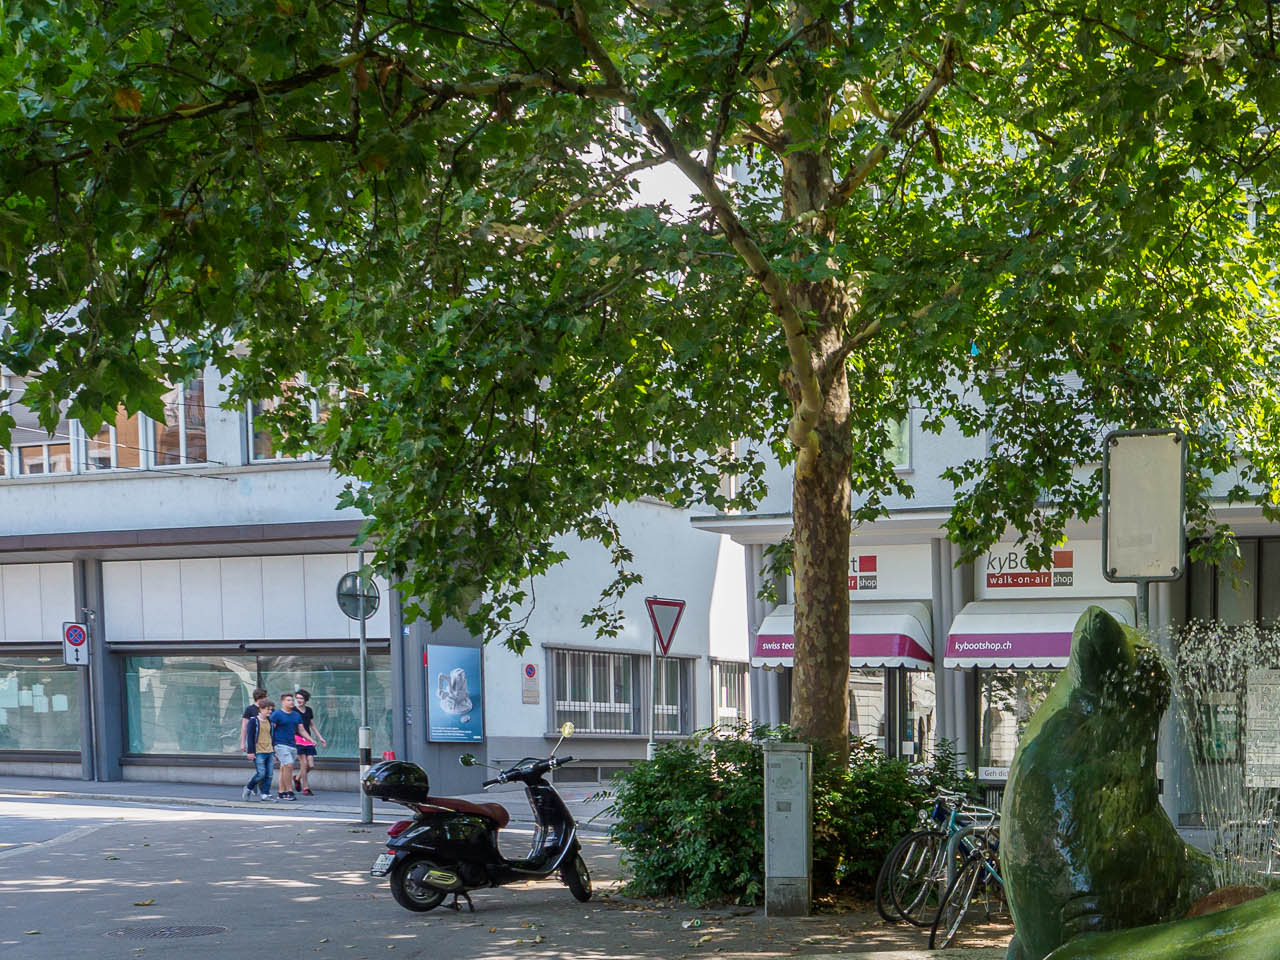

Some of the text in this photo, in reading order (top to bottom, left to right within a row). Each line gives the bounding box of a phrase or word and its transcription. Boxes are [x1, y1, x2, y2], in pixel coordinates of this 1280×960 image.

[859, 577, 877, 588] shop
[989, 574, 1073, 585] walk-on-air shop
[762, 642, 781, 650] swiss
[955, 640, 1012, 651] kybootshop.ch
